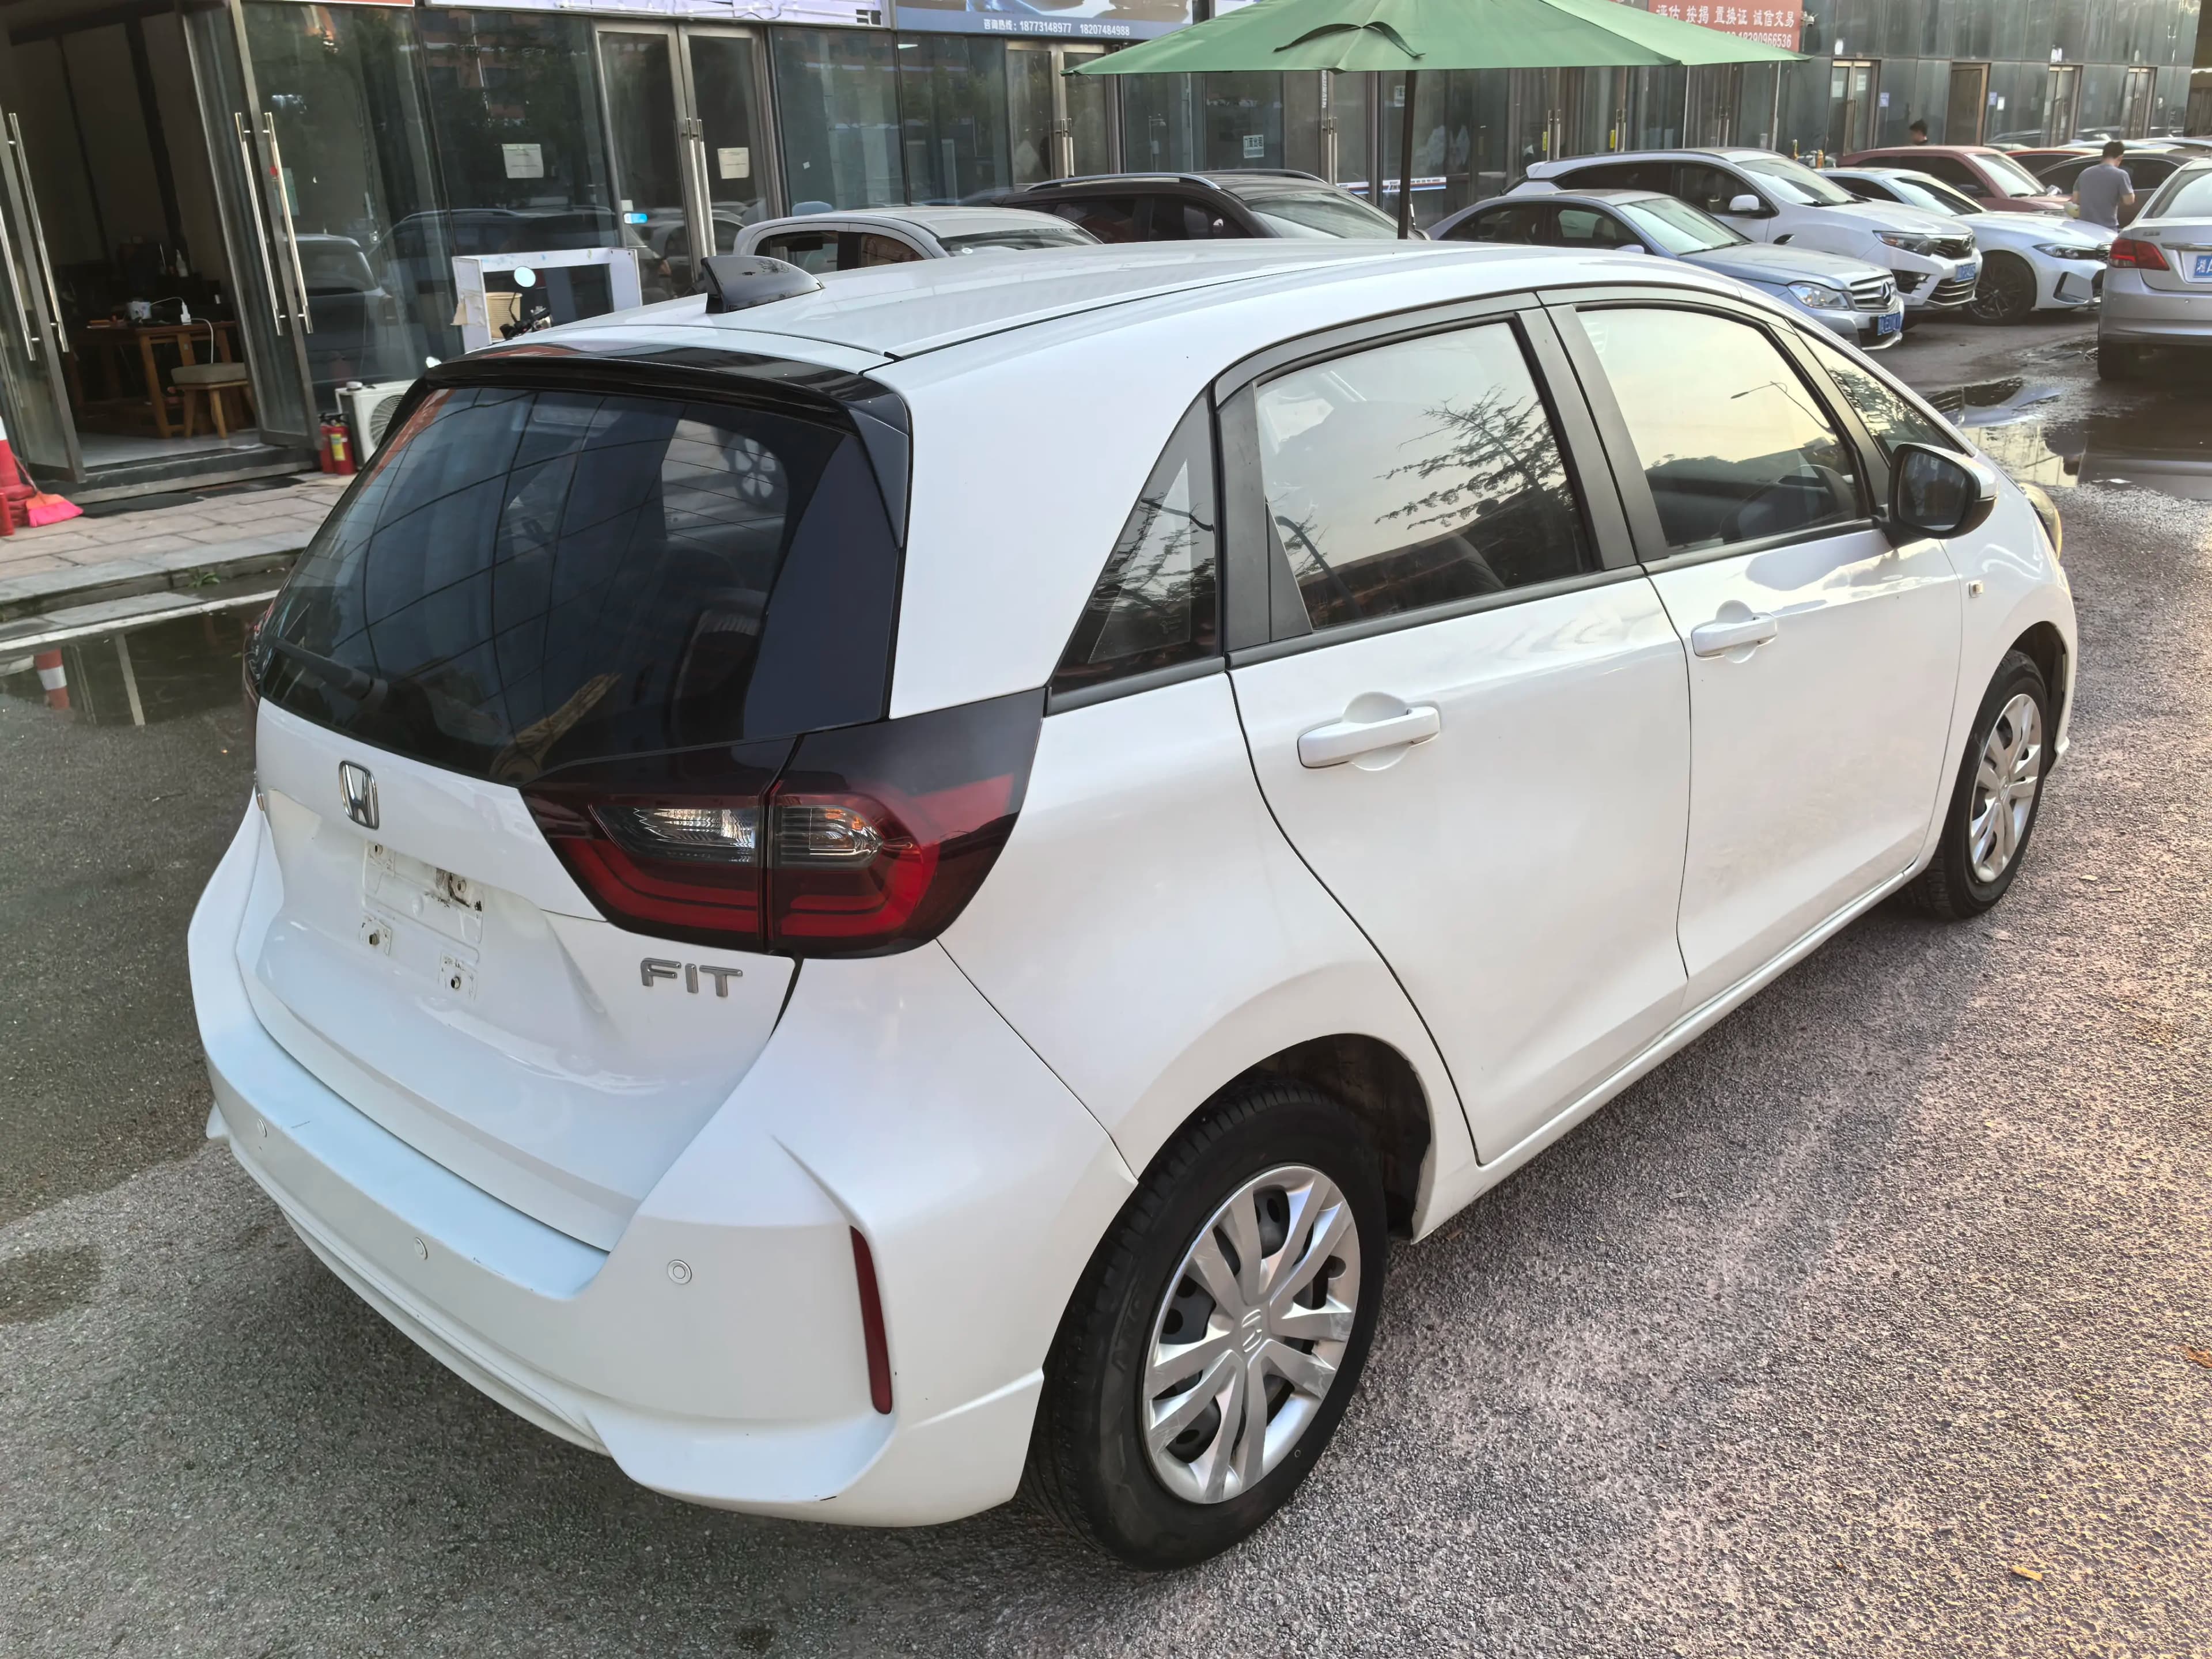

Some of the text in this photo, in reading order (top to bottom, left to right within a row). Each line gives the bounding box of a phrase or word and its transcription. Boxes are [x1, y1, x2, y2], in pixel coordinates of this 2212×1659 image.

[1685, 5, 1709, 24] 按揭
[1714, 6, 1748, 25] 置换证
[1753, 10, 1794, 28] 诚信交易
[641, 957, 743, 998] FIT
